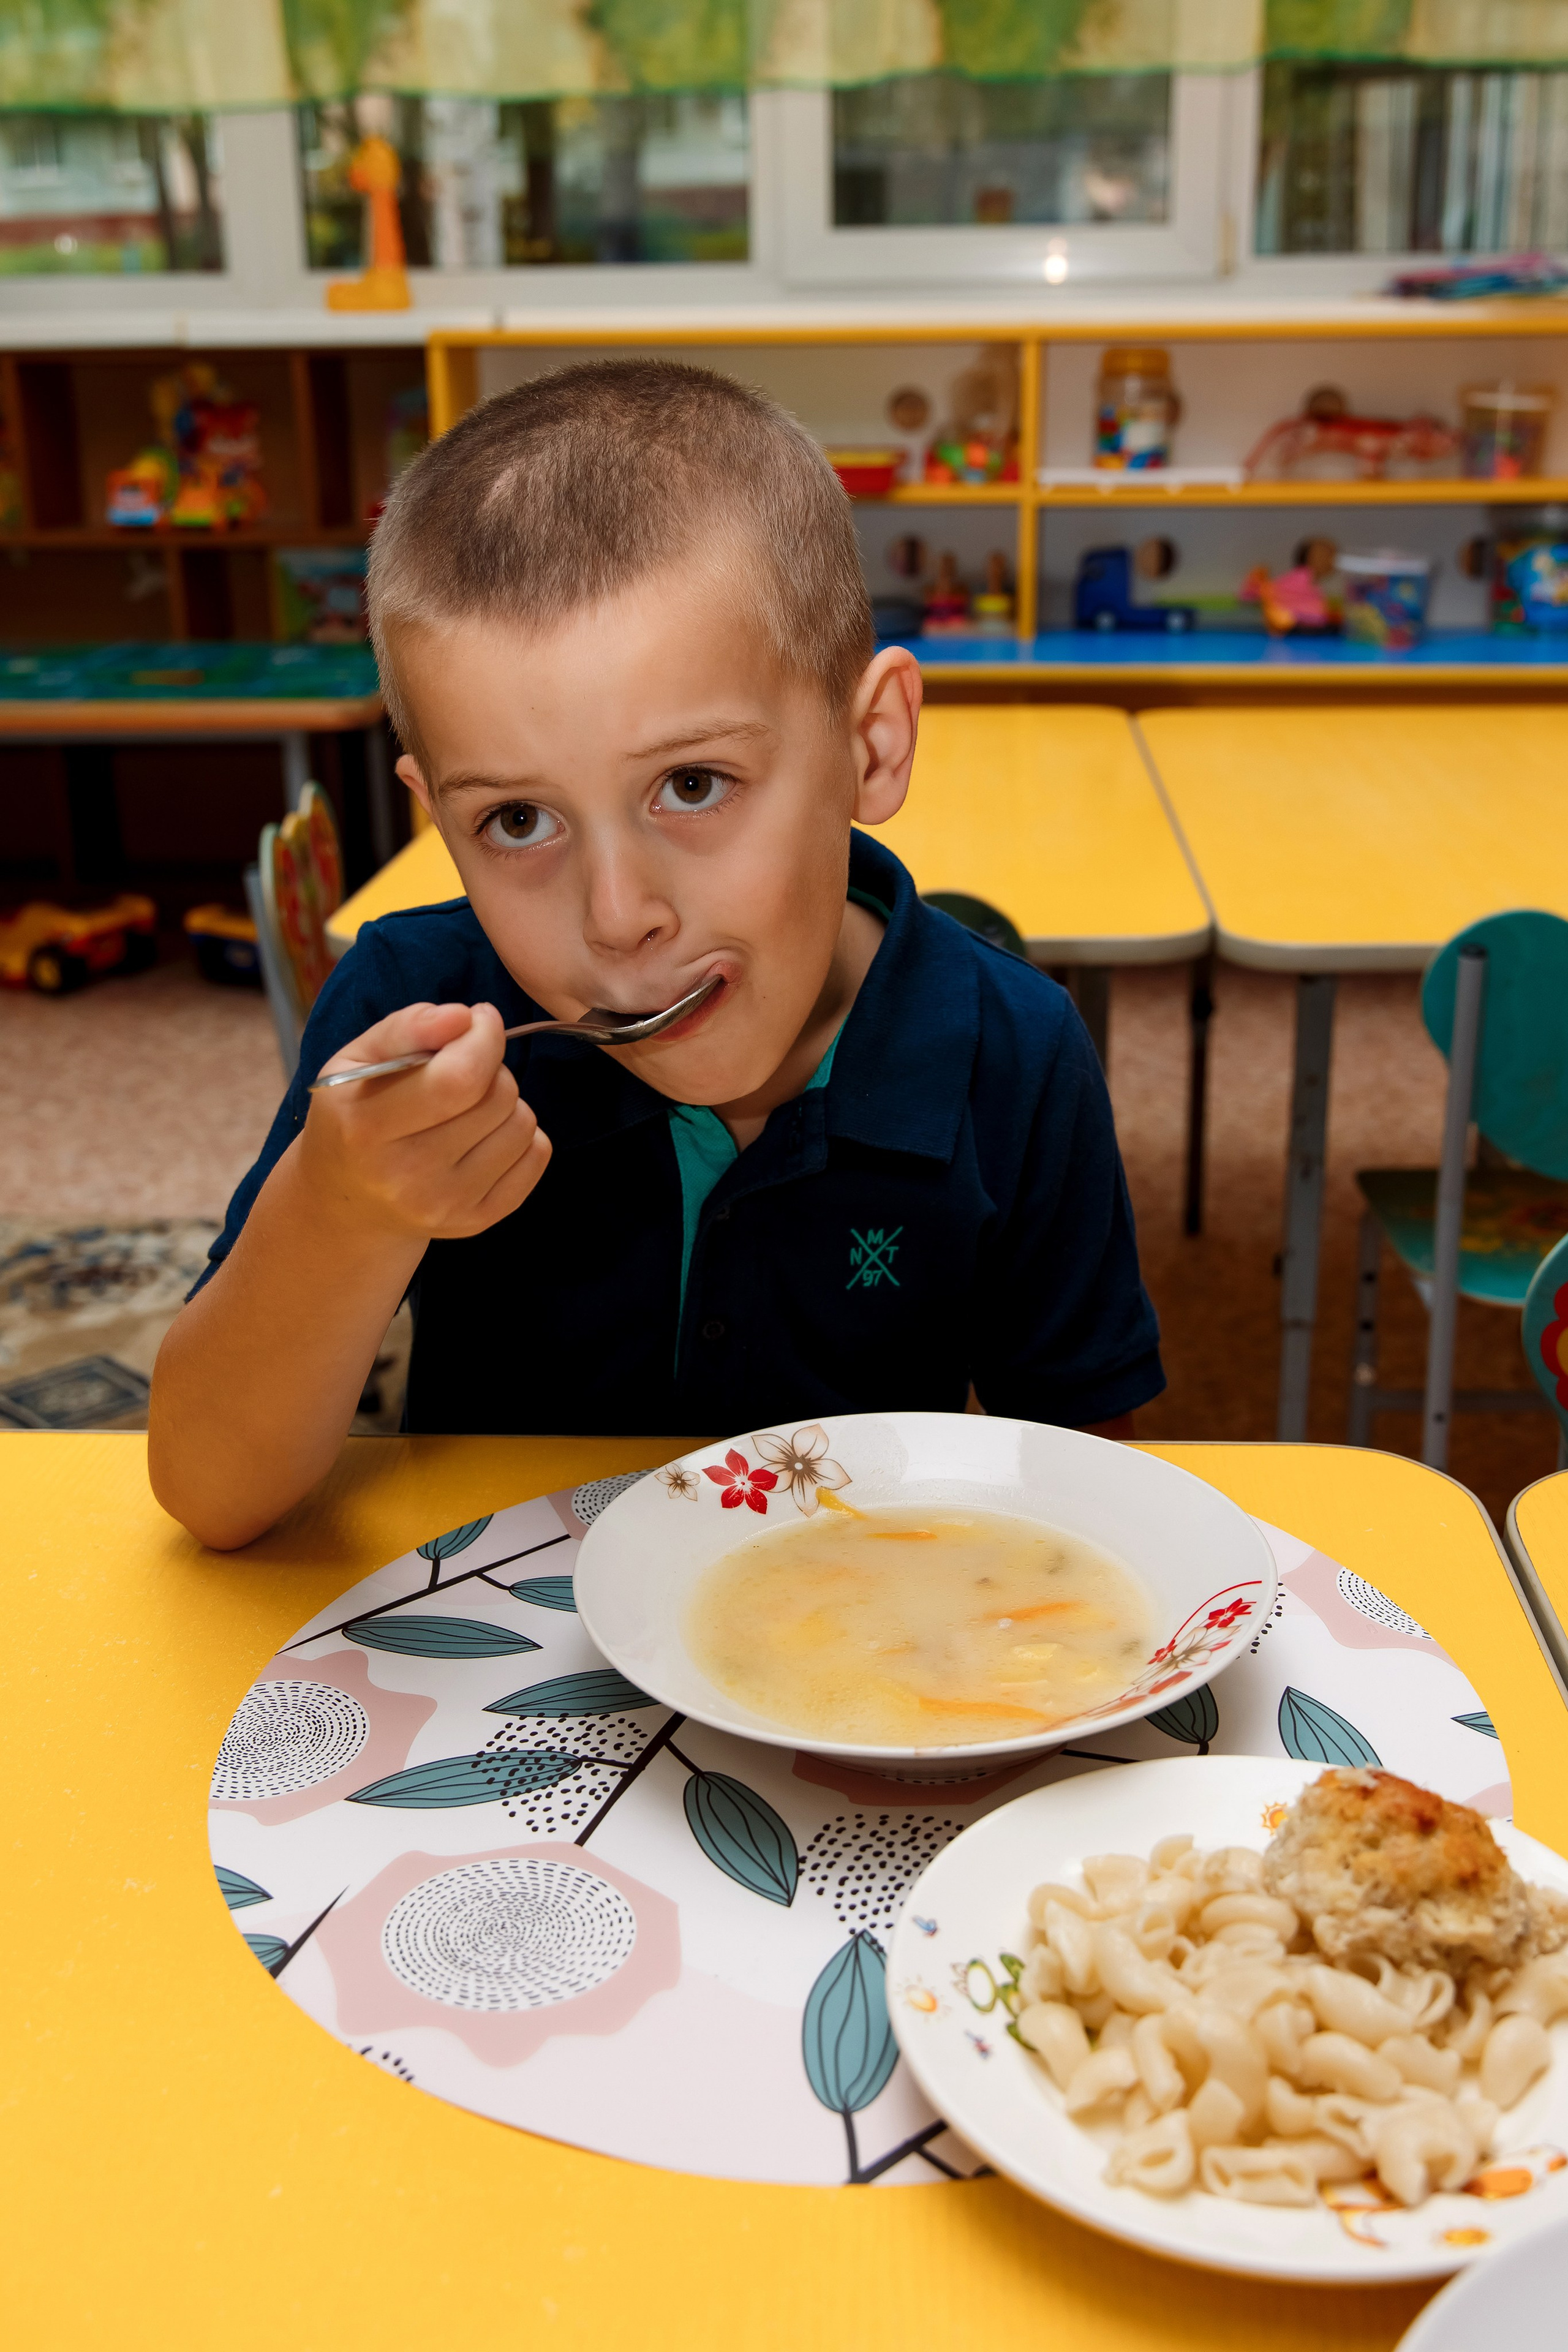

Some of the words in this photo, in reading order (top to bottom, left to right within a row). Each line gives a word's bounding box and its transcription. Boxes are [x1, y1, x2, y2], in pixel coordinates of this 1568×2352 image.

[867, 1229, 883, 1244] M
[850, 1247, 862, 1265] N
[886, 1246, 899, 1263] T
[863, 1270, 882, 1286] 97
